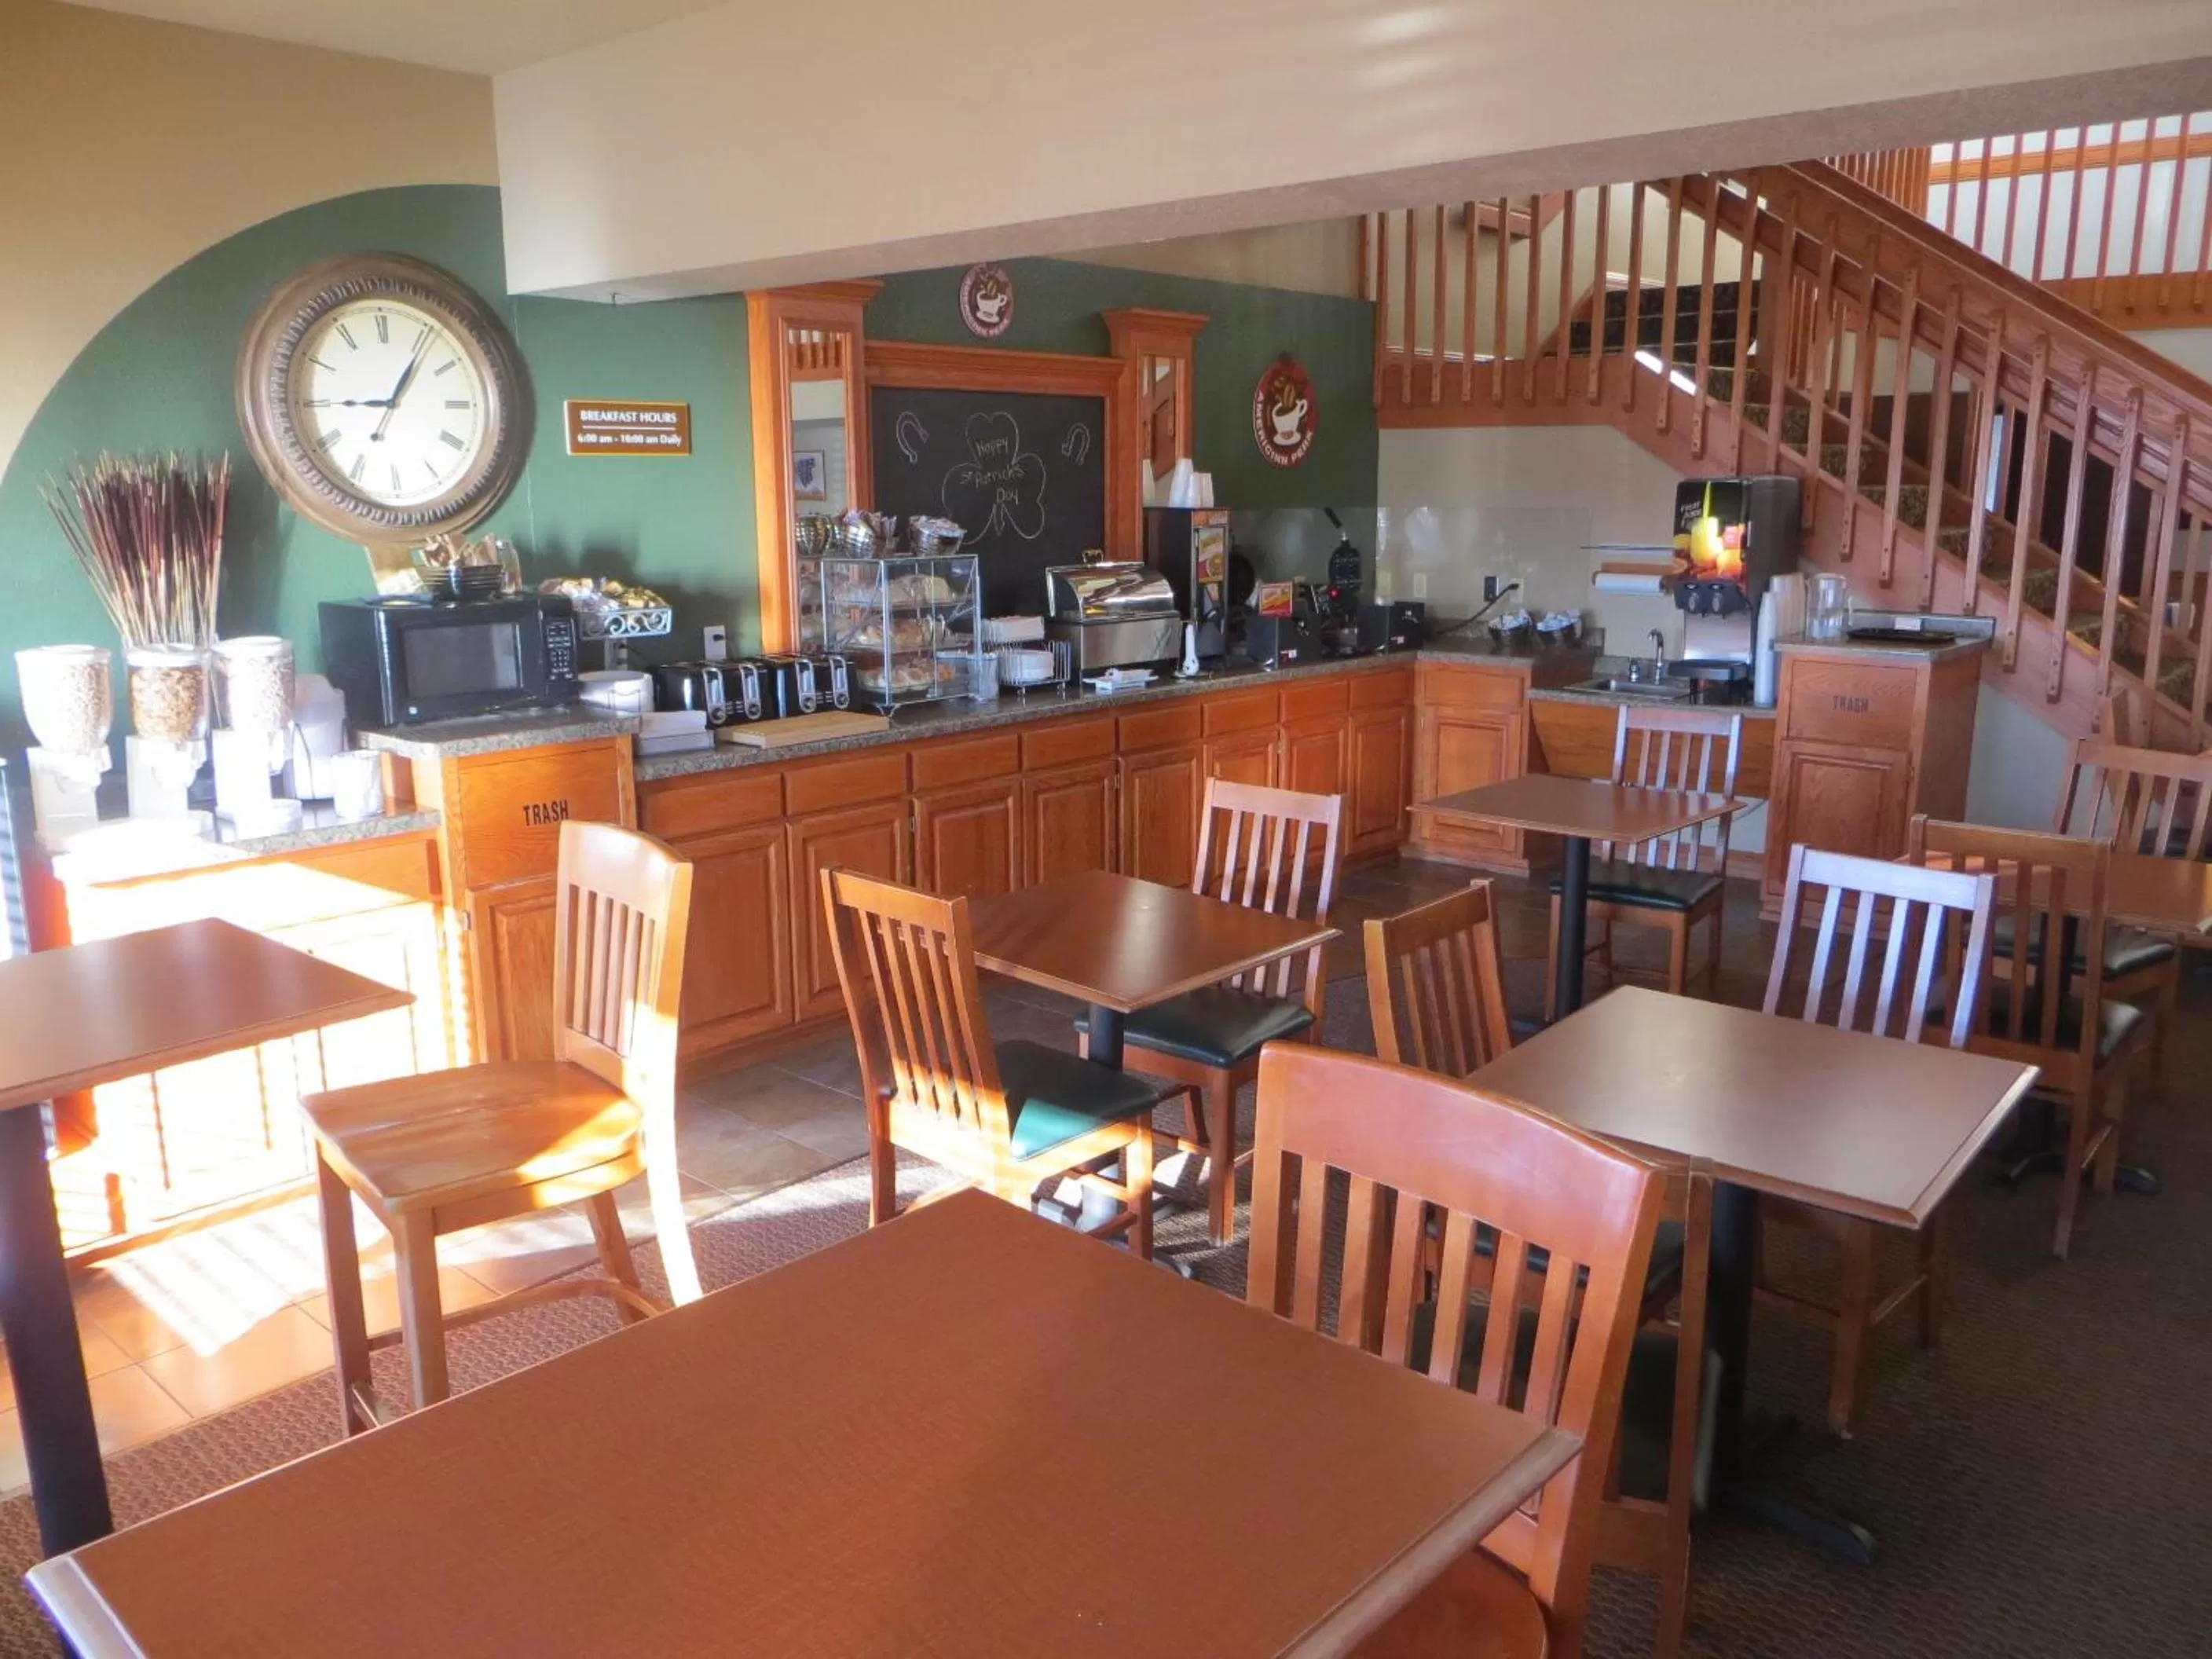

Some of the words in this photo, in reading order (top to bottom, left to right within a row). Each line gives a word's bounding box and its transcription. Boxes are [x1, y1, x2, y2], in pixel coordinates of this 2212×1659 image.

[580, 409, 637, 423] BREAKFAST
[639, 412, 677, 423] HOURS
[599, 435, 613, 444] am
[660, 434, 682, 447] Daily
[996, 487, 1019, 505] Day
[1832, 695, 1869, 713] TRASH
[522, 799, 569, 827] TRASH
